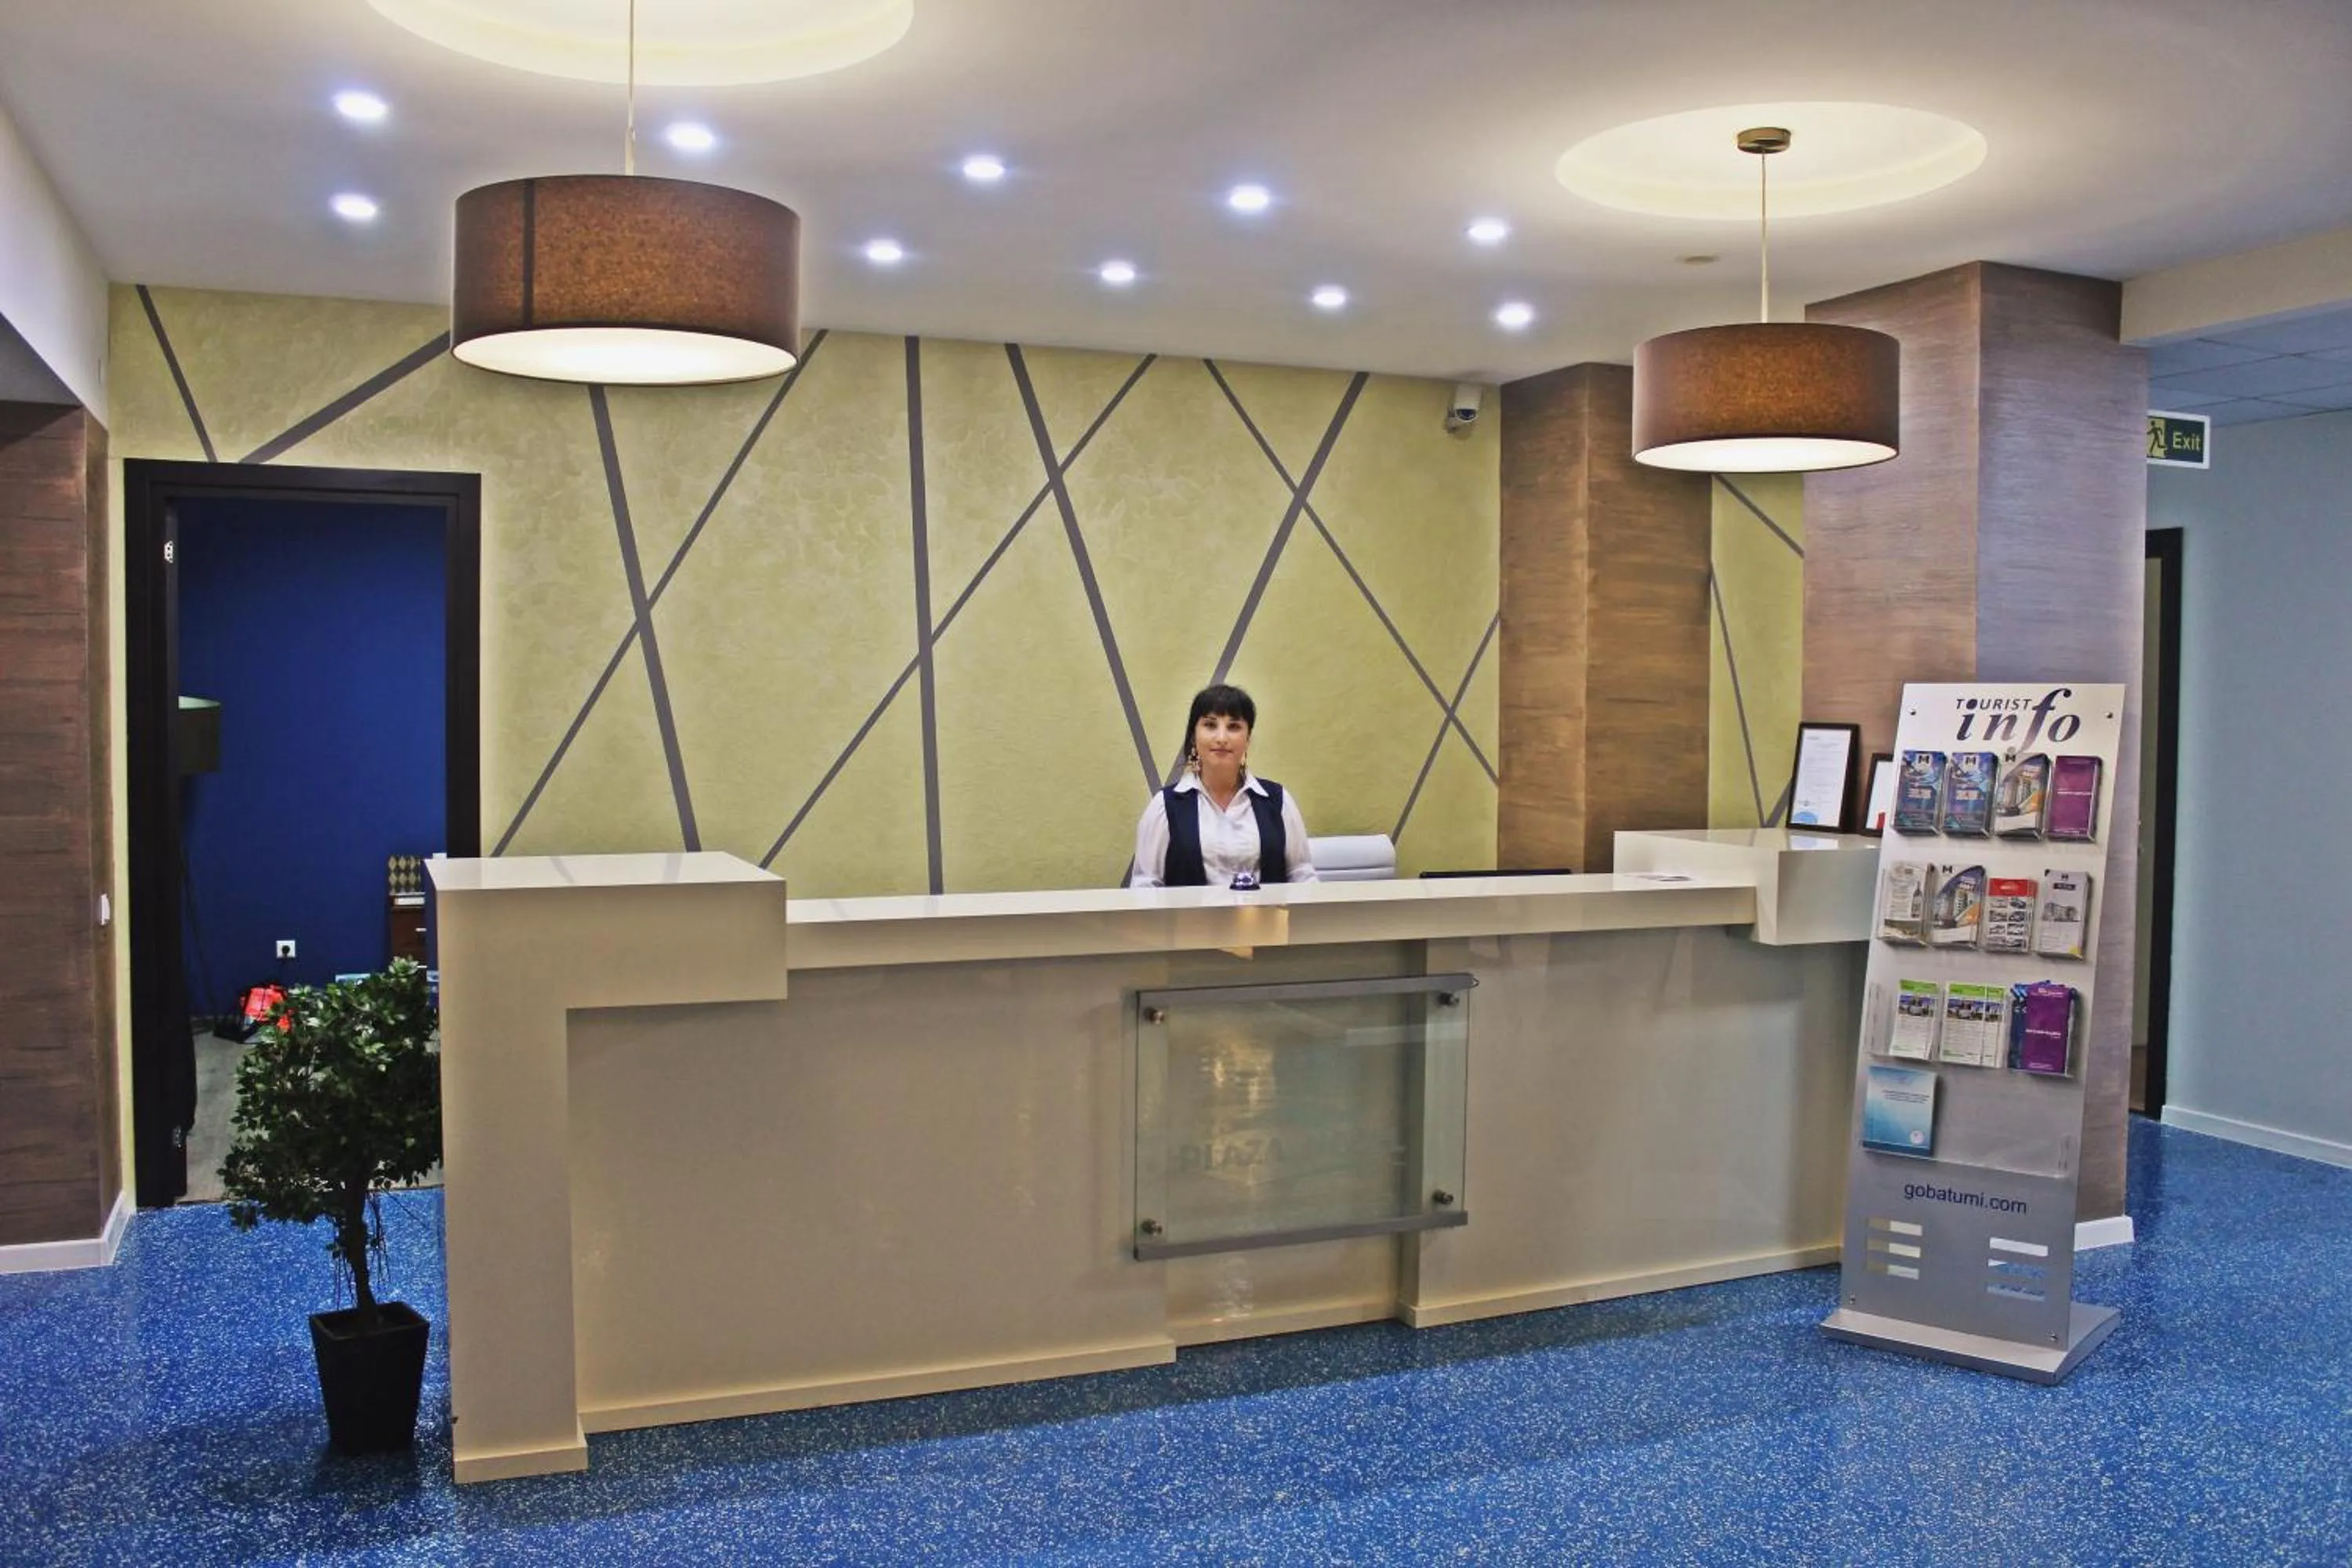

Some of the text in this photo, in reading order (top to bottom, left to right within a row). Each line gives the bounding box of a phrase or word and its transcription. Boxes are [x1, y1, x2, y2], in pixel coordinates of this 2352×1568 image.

[2172, 432, 2201, 452] Exit
[1956, 699, 2032, 710] TOURIST
[1956, 688, 2082, 754] info
[1904, 1184, 2027, 1214] gobatumi.com
